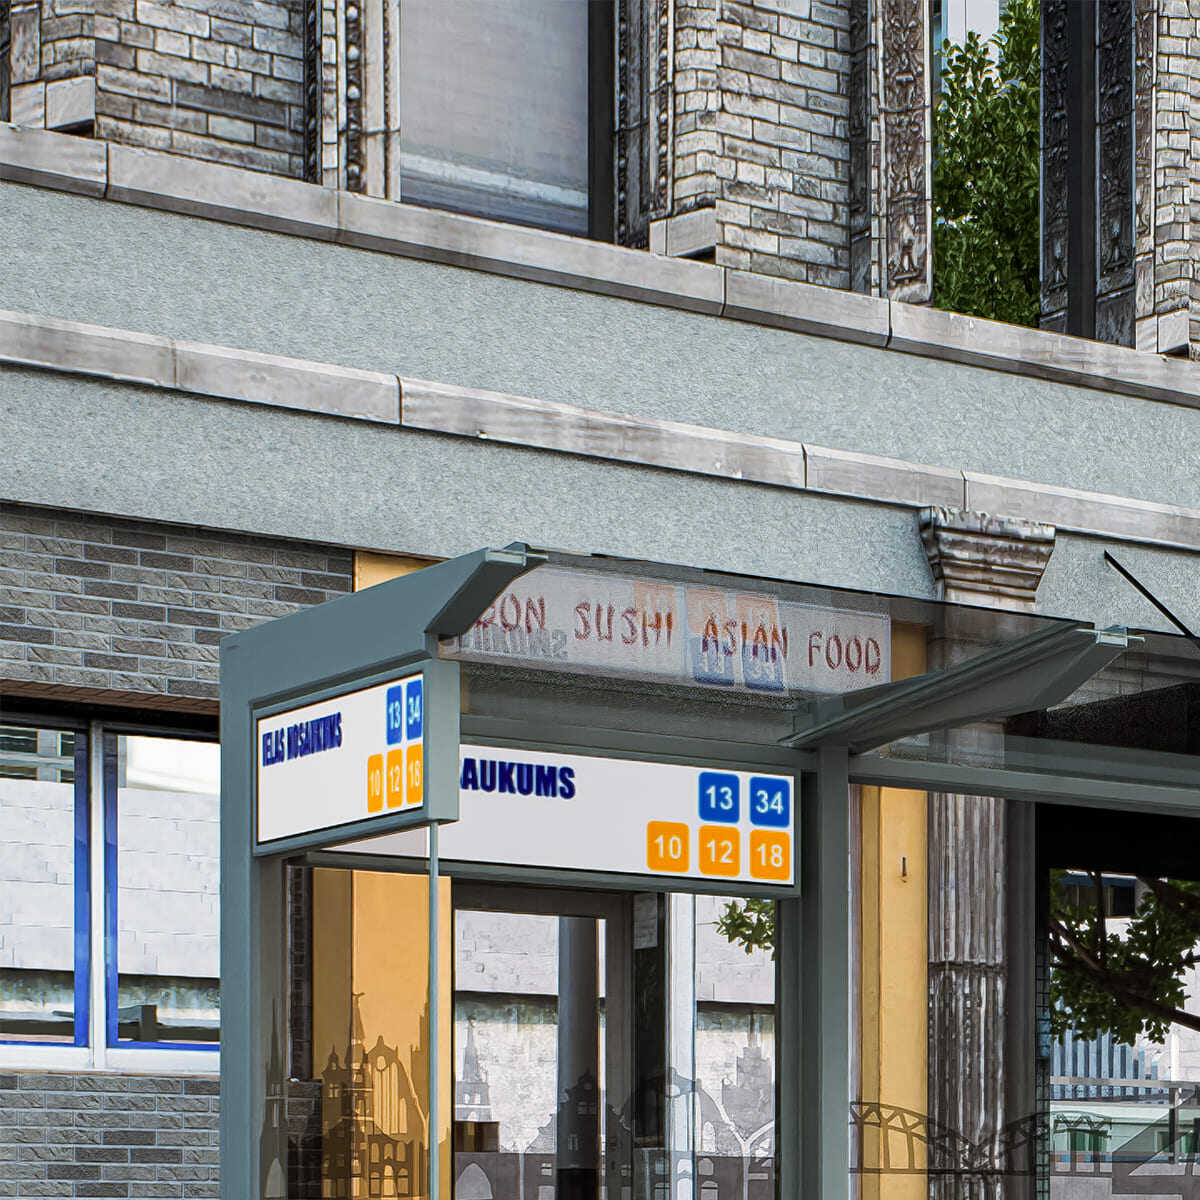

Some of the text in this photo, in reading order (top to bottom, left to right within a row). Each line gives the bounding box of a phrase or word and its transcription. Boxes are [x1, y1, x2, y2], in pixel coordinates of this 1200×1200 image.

[574, 601, 673, 648] SUSHI
[701, 613, 788, 663] ASIAN
[808, 631, 881, 675] FOOD
[388, 695, 421, 730] 13 34
[370, 760, 420, 797] 10 12 18
[705, 785, 784, 815] 13 34
[654, 835, 783, 868] 10 12 18
